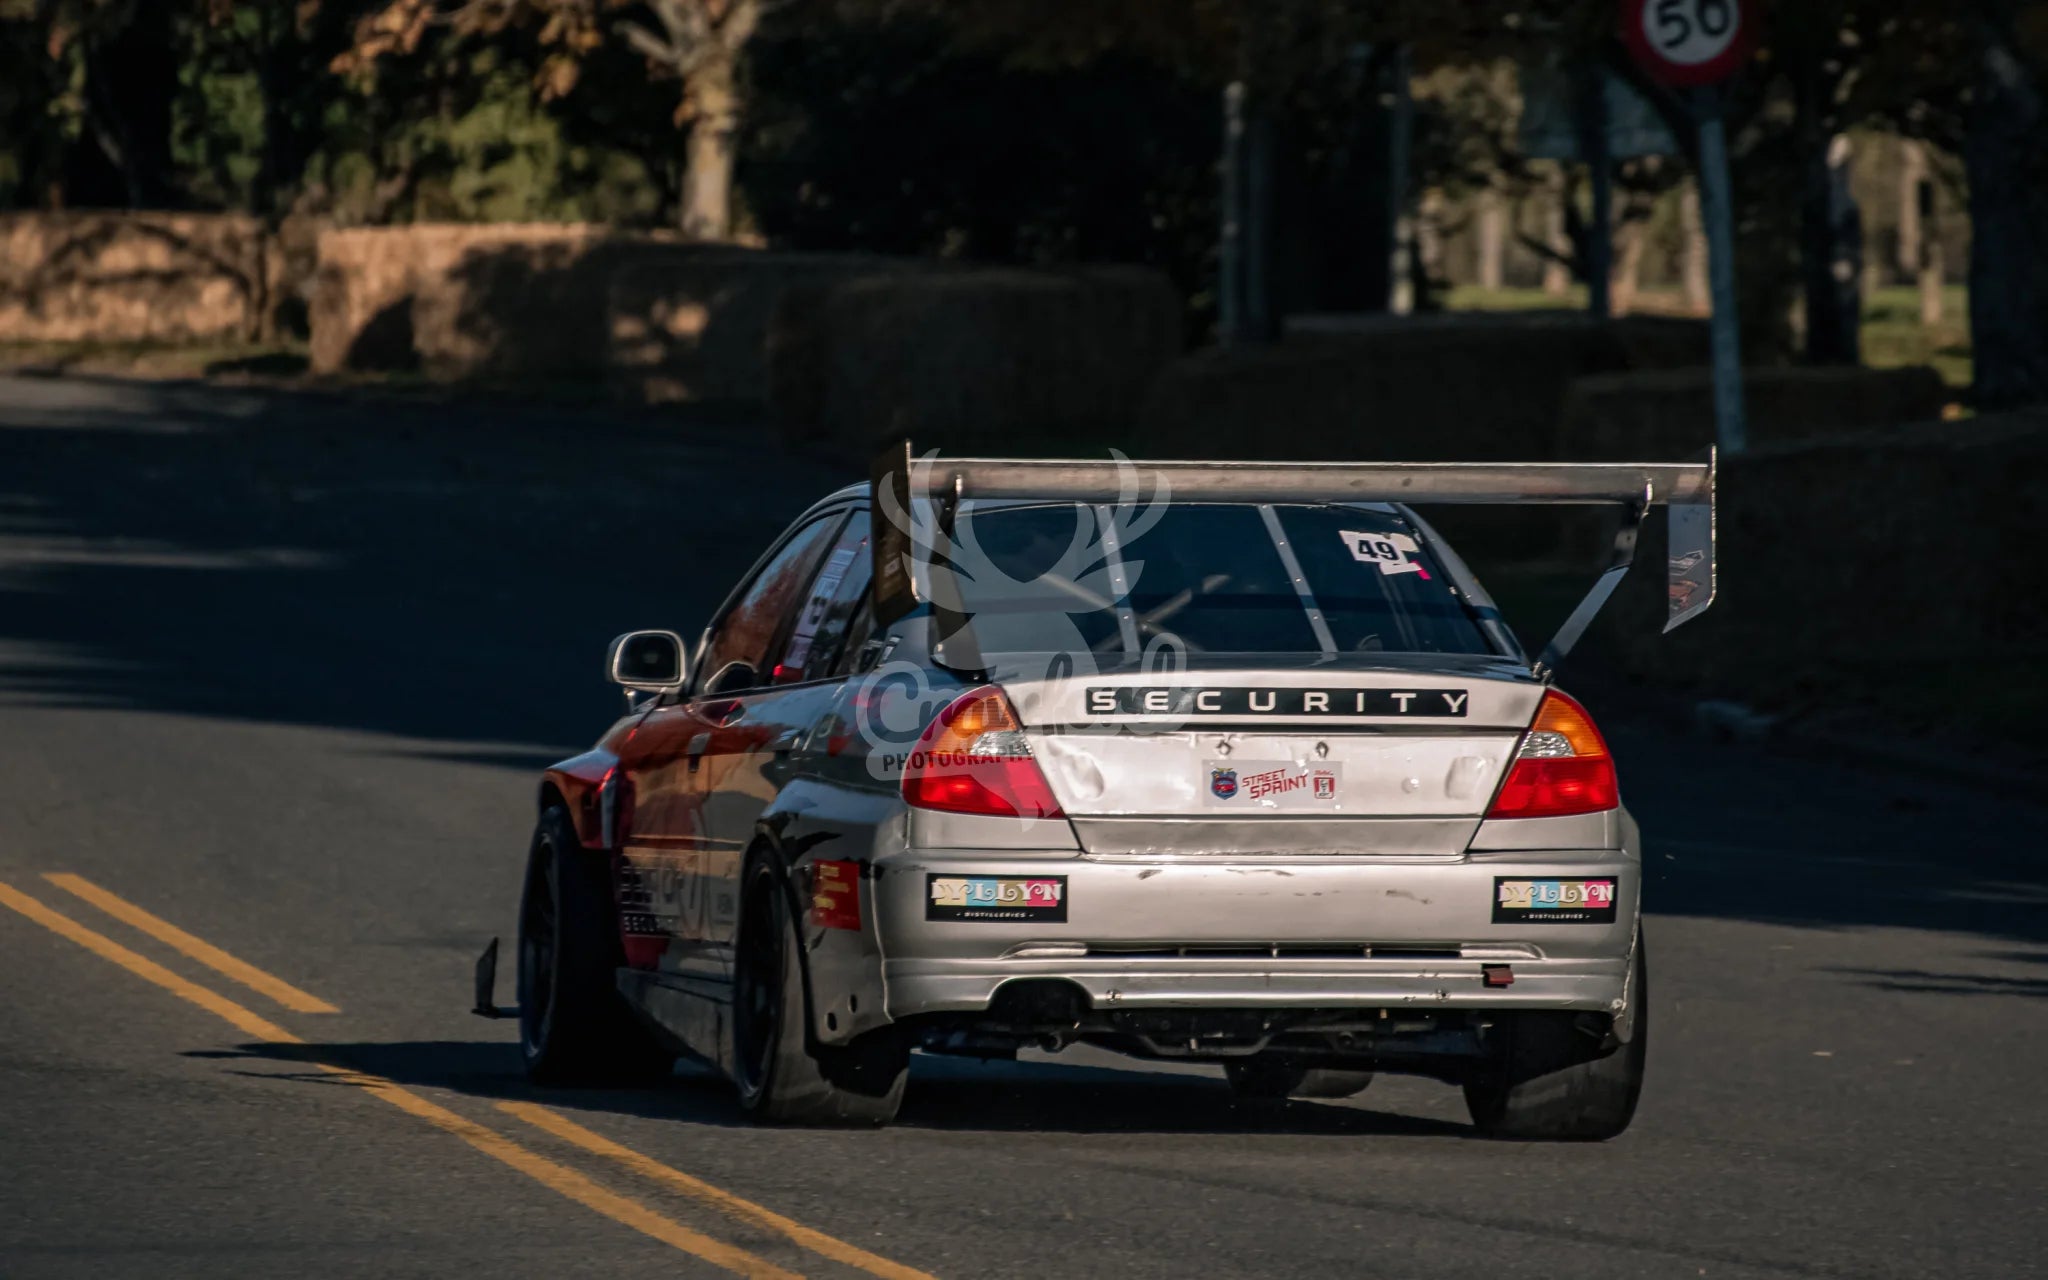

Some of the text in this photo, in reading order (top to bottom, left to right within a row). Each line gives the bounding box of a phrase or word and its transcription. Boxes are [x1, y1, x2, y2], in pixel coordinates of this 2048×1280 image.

[1656, 0, 1730, 48] 50
[1358, 539, 1400, 561] 49
[1091, 689, 1468, 714] SECURITY
[1241, 768, 1286, 788] STREET
[1250, 773, 1309, 799] SPRINT
[930, 882, 1064, 902] DYLLYN
[1498, 884, 1615, 903] DYLLYN
